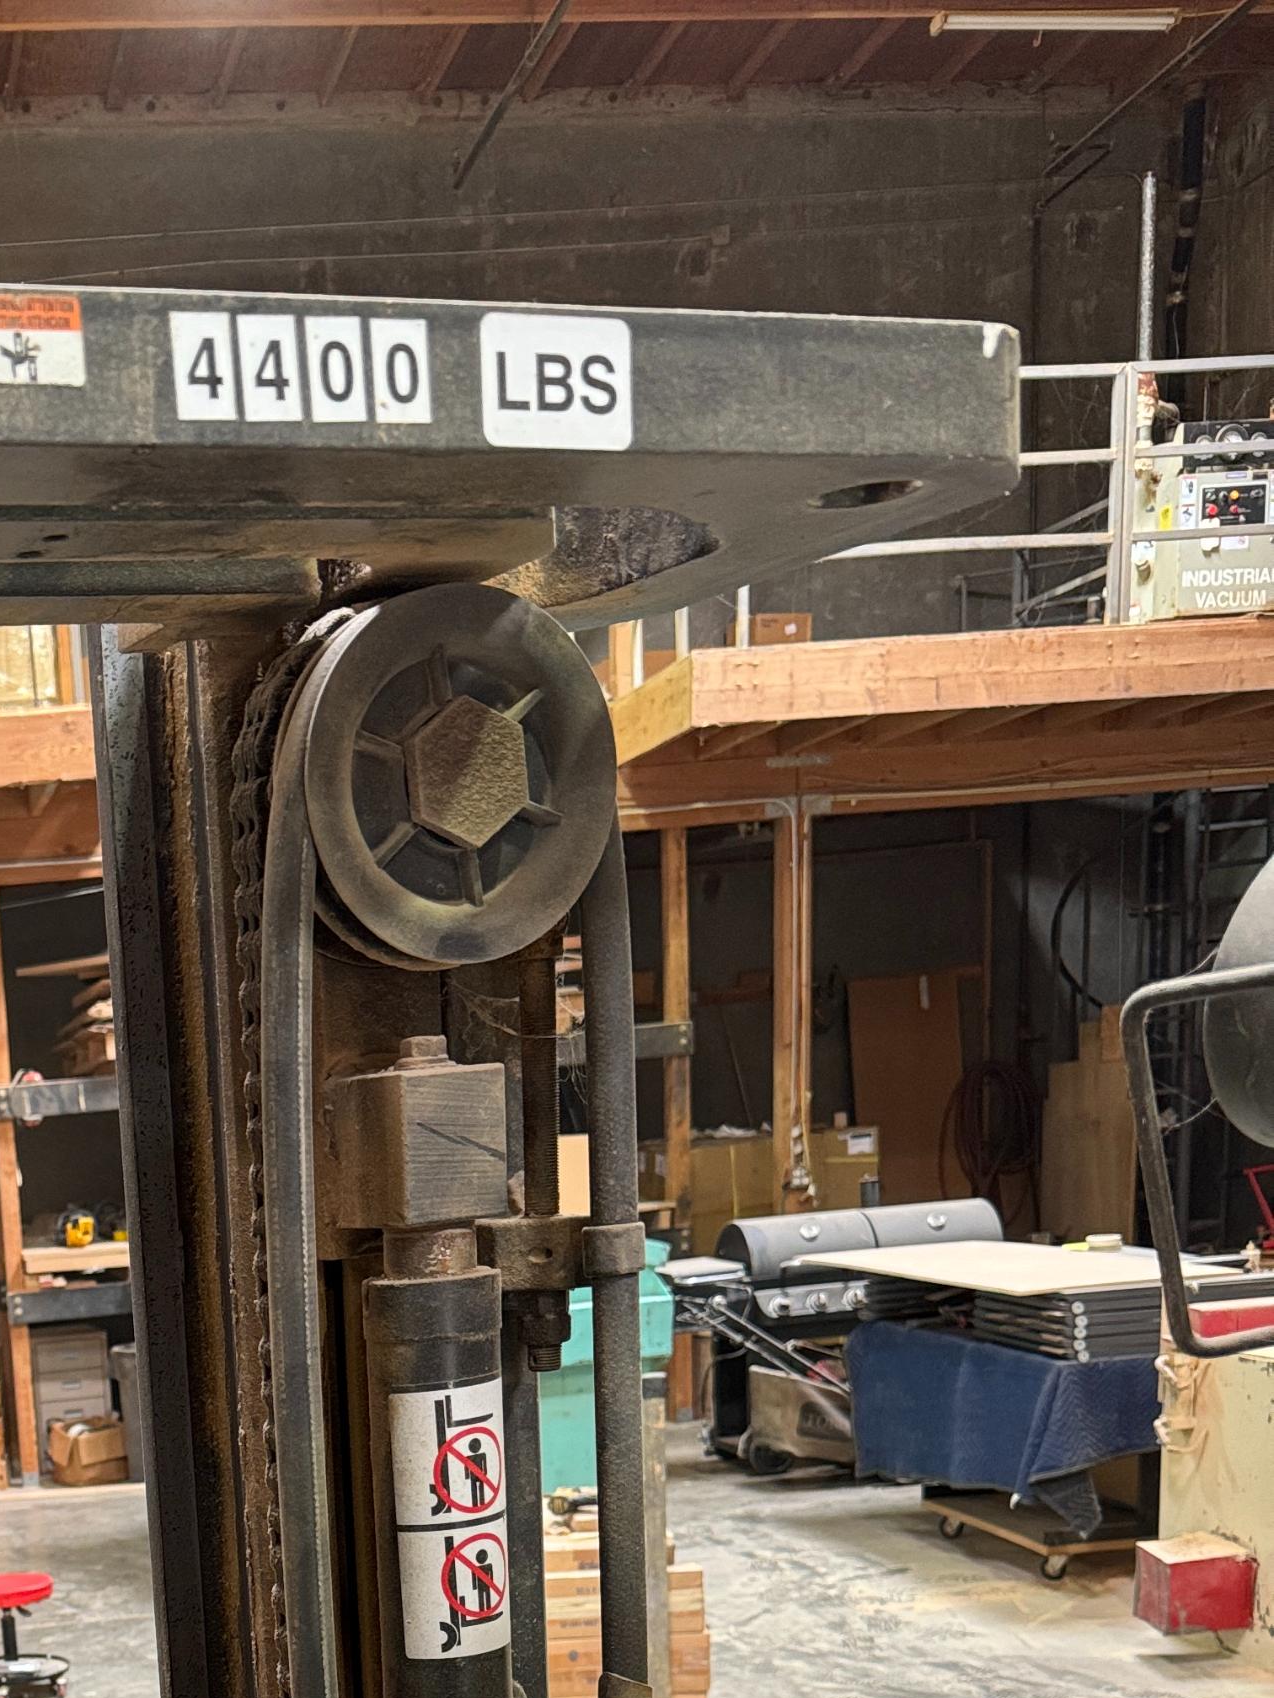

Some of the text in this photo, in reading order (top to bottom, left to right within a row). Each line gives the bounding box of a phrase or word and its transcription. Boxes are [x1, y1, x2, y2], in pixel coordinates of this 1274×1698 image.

[187, 337, 420, 404] 4400
[495, 351, 618, 415] LBS
[1181, 567, 1274, 588] INDUSTRIA
[1195, 589, 1267, 609] VACUUM
